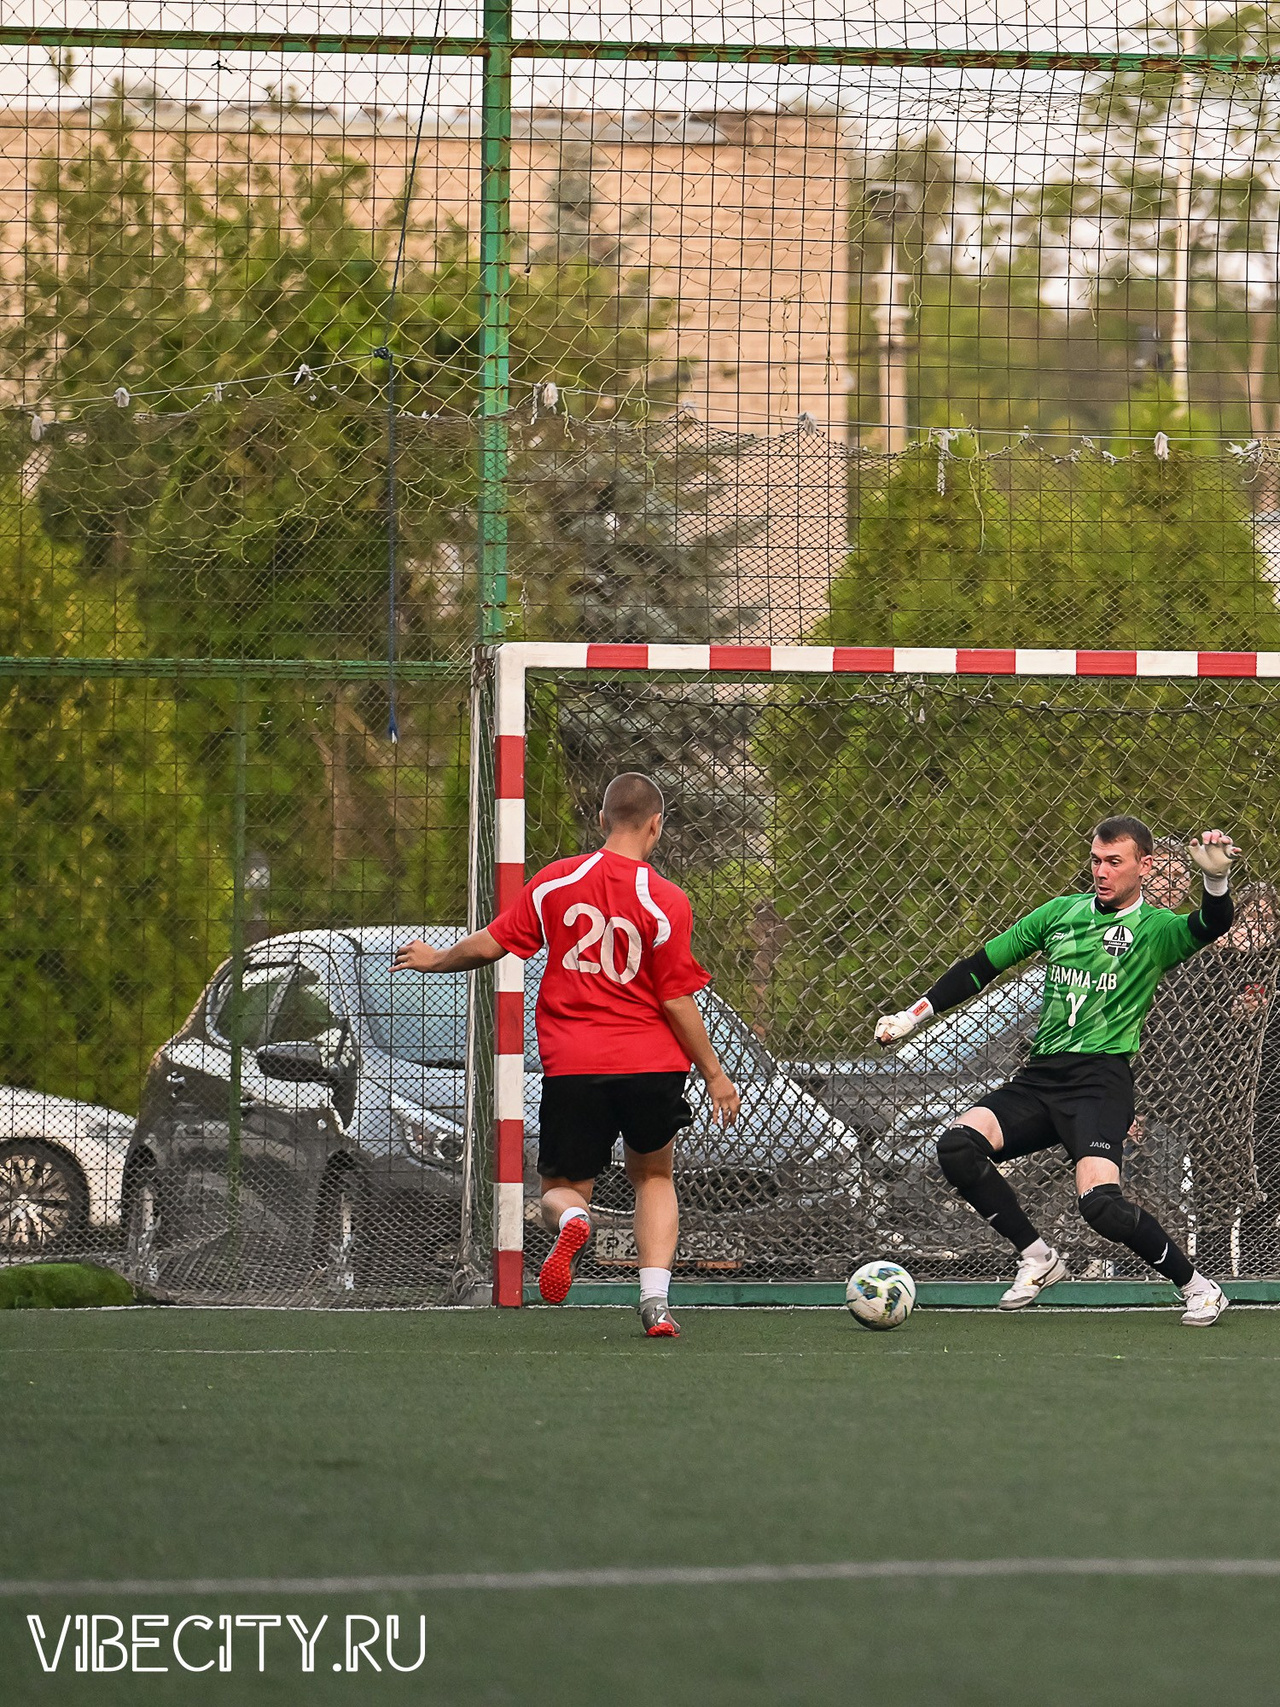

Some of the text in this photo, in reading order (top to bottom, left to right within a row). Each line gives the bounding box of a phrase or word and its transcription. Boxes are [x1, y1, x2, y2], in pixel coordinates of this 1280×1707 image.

[562, 902, 642, 985] 20
[1050, 964, 1118, 992] ГАММА-ДВ
[1089, 1141, 1111, 1150] JAKO
